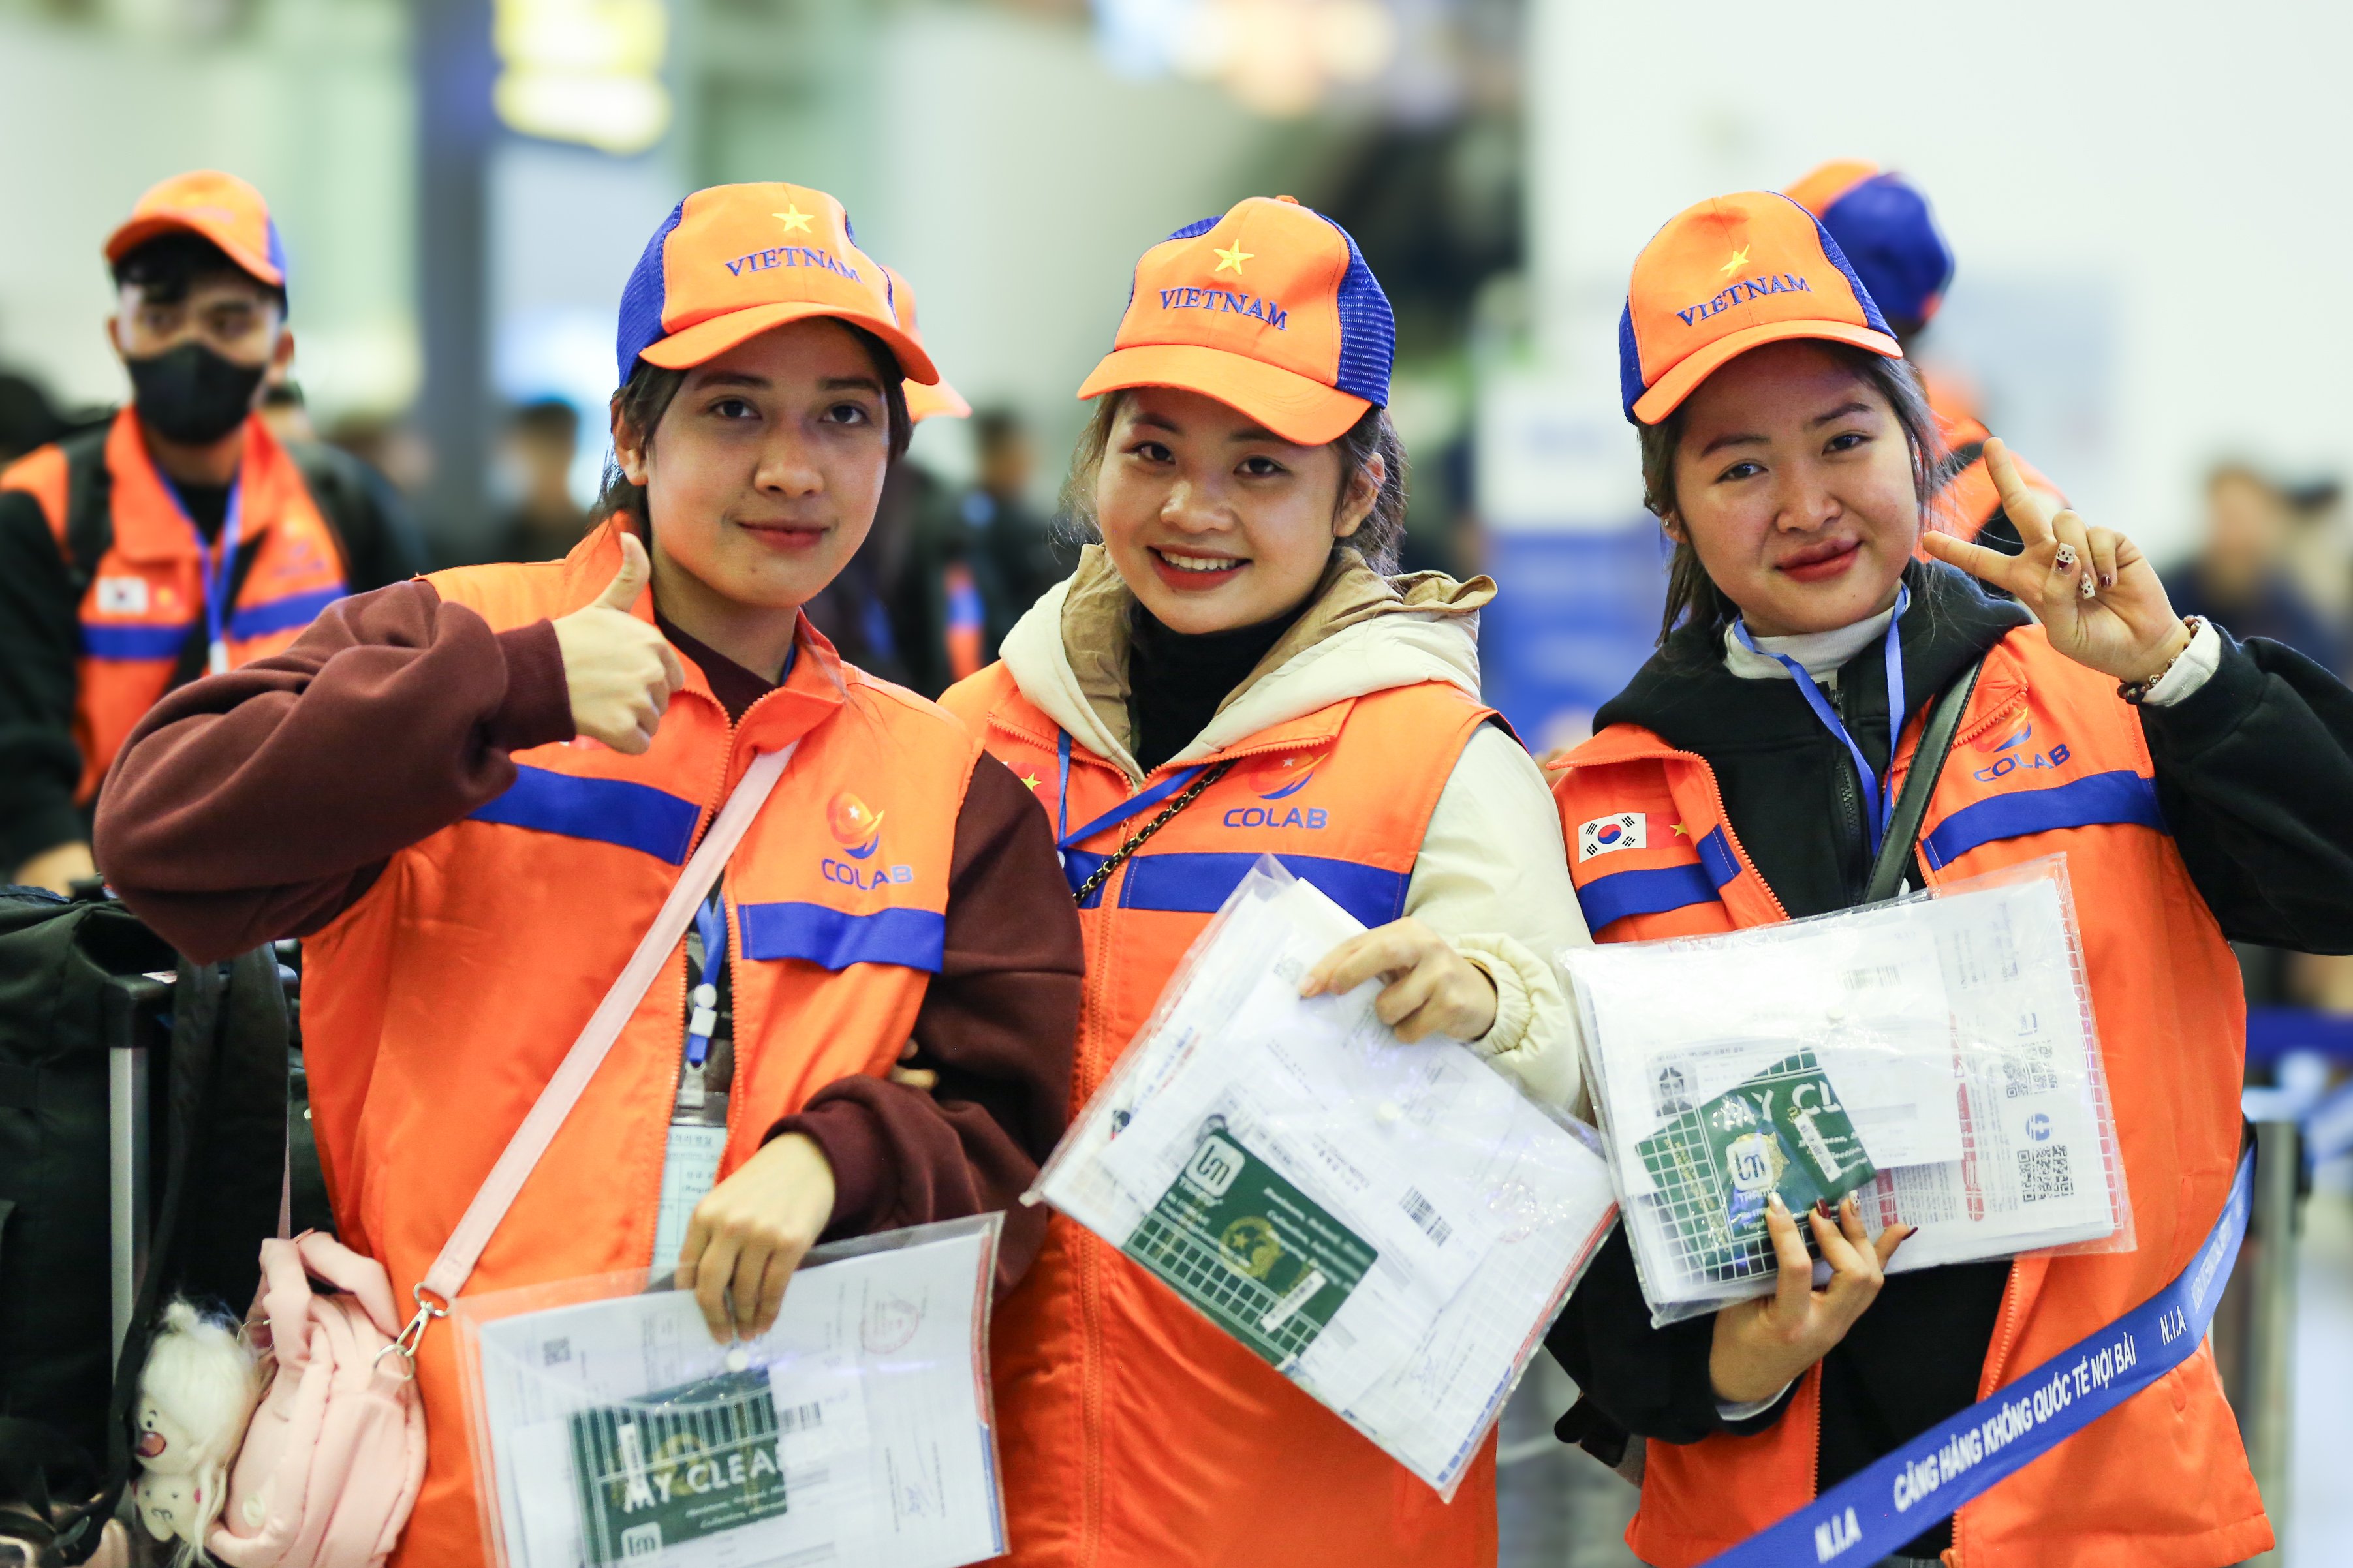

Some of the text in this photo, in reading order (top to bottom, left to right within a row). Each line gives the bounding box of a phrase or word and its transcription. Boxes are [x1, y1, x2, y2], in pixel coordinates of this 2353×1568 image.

[725, 246, 865, 285] VIETNAM
[1159, 287, 1288, 331] VIETNAM
[1676, 272, 1814, 327] VIETNAM
[1972, 743, 2071, 782] COLAB
[1223, 807, 1329, 829] COLAB
[821, 857, 914, 891] COLAB
[2159, 1305, 2187, 1345] N.I.A
[1893, 1331, 2138, 1513] CẢNG HÀNG KHÔNG QUỐC TẾ NỘI BÀI
[1815, 1507, 1862, 1563] N.I.A
